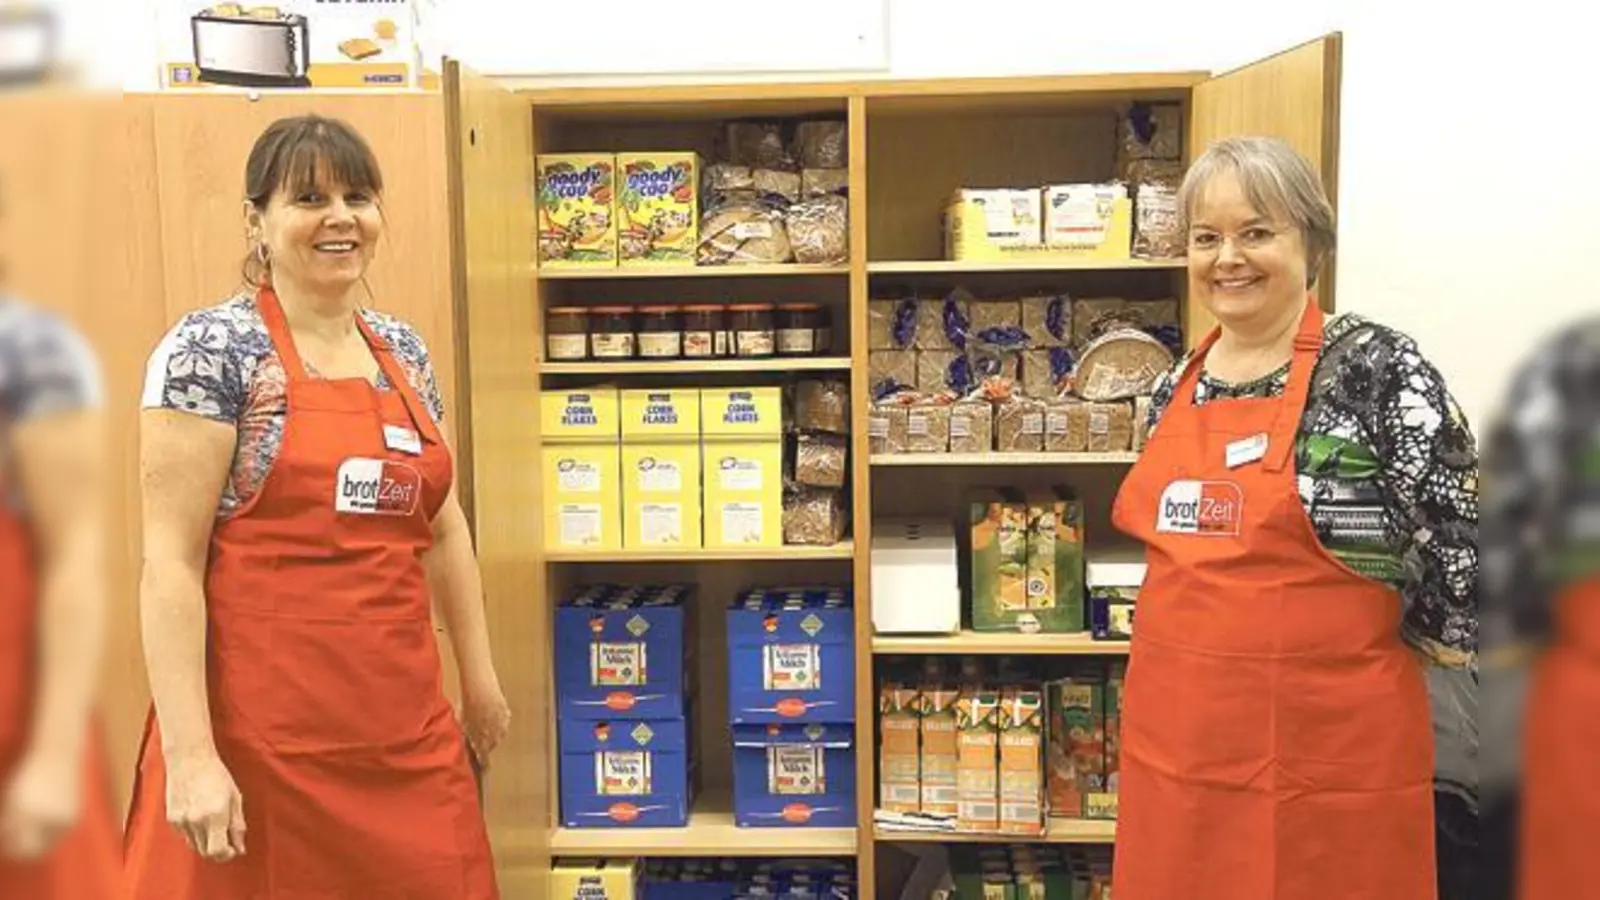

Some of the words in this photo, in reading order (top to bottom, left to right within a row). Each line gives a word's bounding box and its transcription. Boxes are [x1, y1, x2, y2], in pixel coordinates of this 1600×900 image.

[628, 165, 682, 188] goody
[343, 473, 415, 502] brotZeit
[1165, 497, 1233, 521] brotZeit
